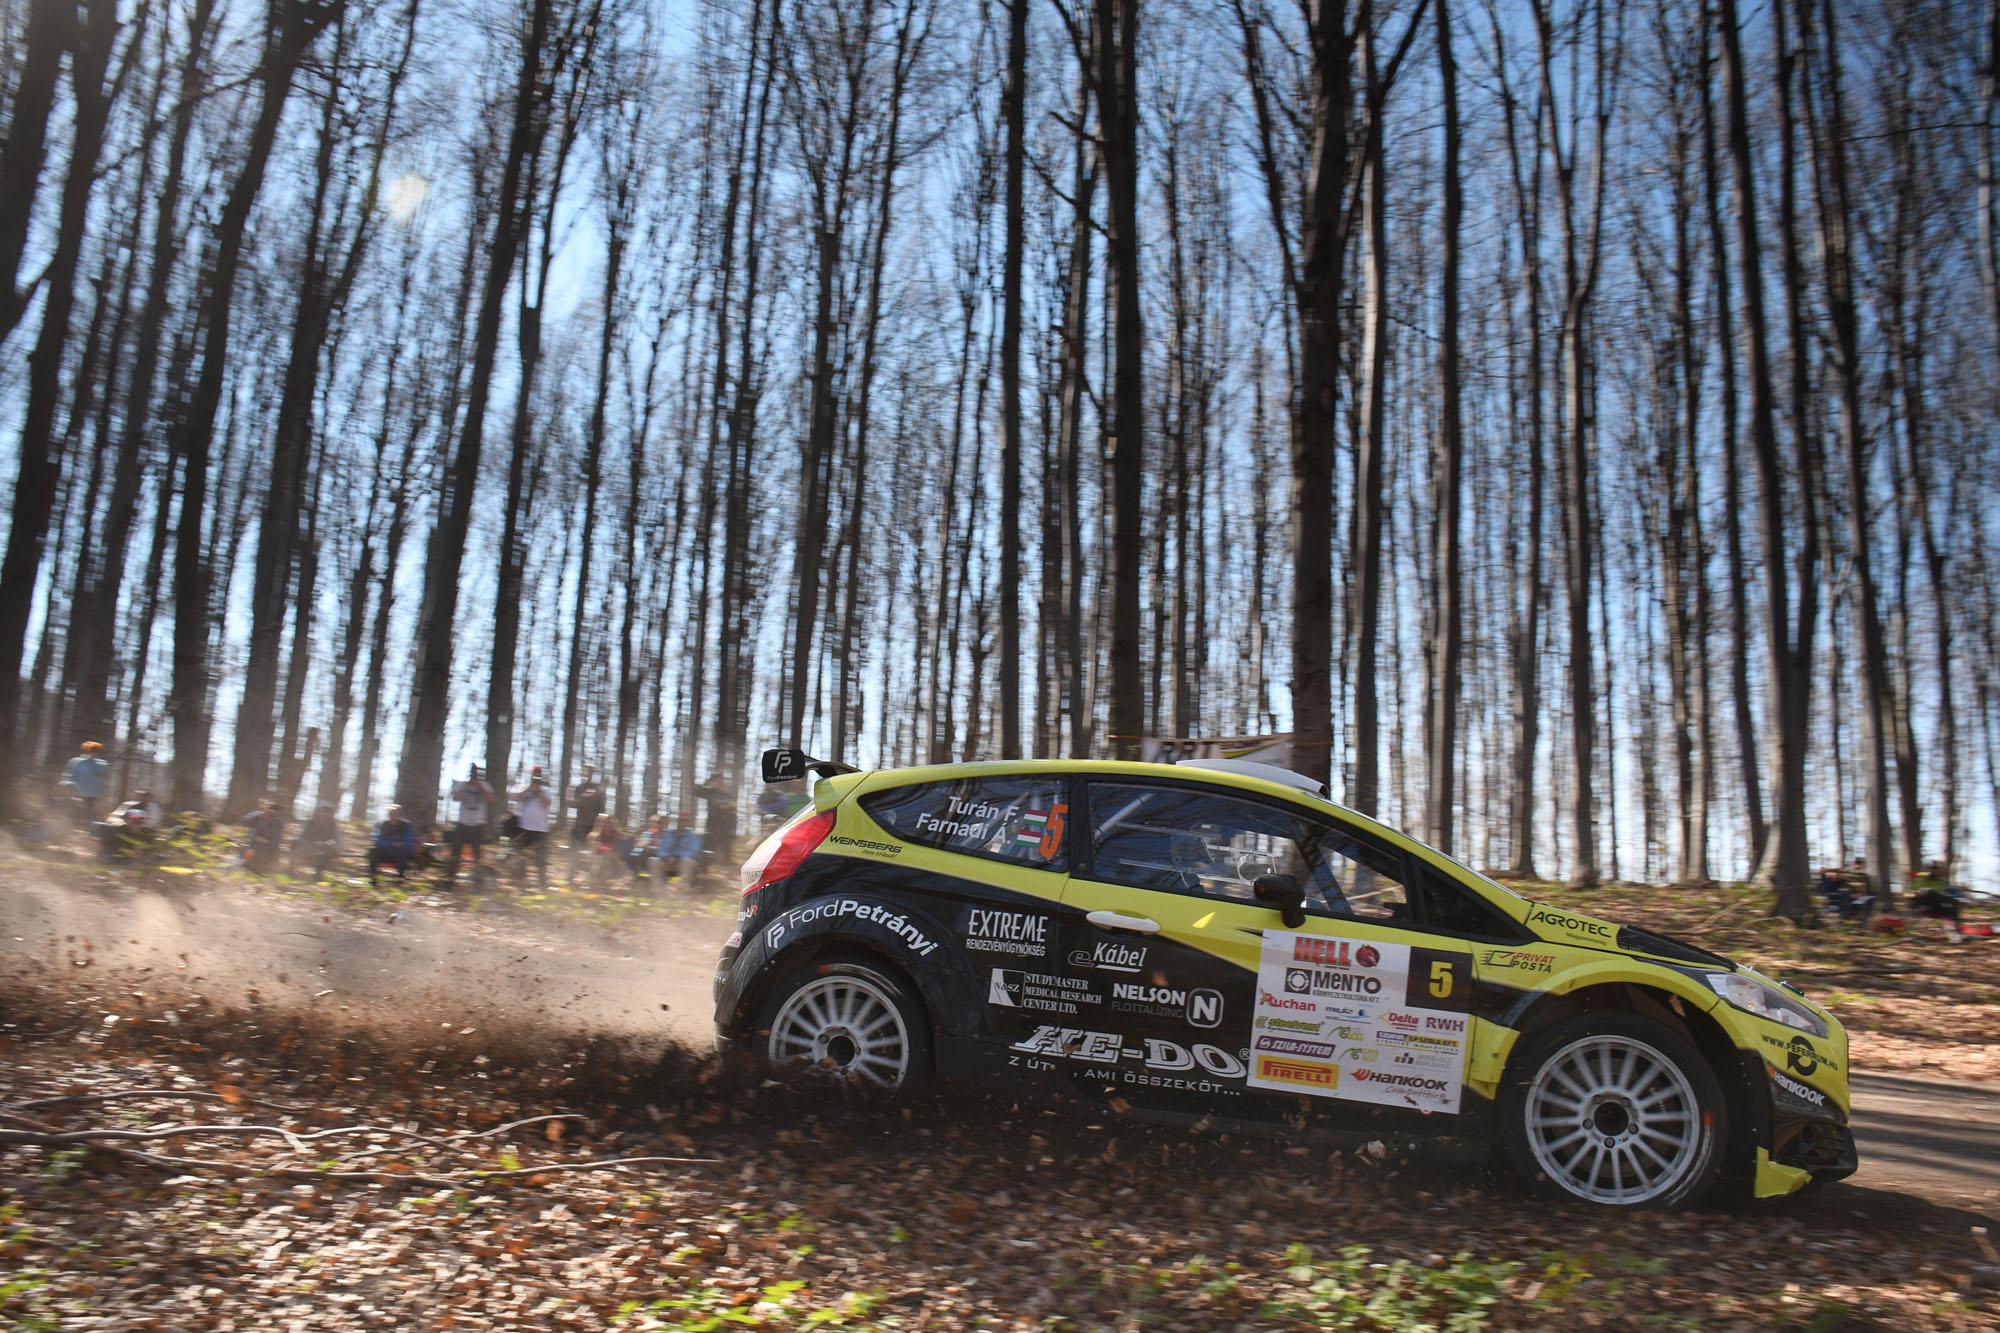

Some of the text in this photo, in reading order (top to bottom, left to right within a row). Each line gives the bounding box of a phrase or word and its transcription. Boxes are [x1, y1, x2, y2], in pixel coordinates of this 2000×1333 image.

[948, 796, 1020, 823] Turán F.
[915, 812, 1011, 844] Farnadi Á.
[1039, 803, 1069, 858] 5
[830, 835, 903, 853] WEINSBERG
[968, 909, 1049, 943] EXTREME
[1531, 911, 1612, 938] AGROTEC
[1293, 936, 1352, 967] HELL
[1512, 960, 1552, 973] POSTA
[1026, 973, 1089, 990] STUDYMASTER
[1429, 961, 1453, 998] 5
[1023, 998, 1078, 1014] CENTER LTD.
[1024, 986, 1102, 1004] MEDICAL RESEARCH
[1112, 983, 1186, 1006] NELSON
[1259, 990, 1317, 1012] Auchan
[1388, 1012, 1419, 1024] Delta
[1426, 1017, 1464, 1032] RWH
[1263, 1060, 1333, 1084] PIRELLI
